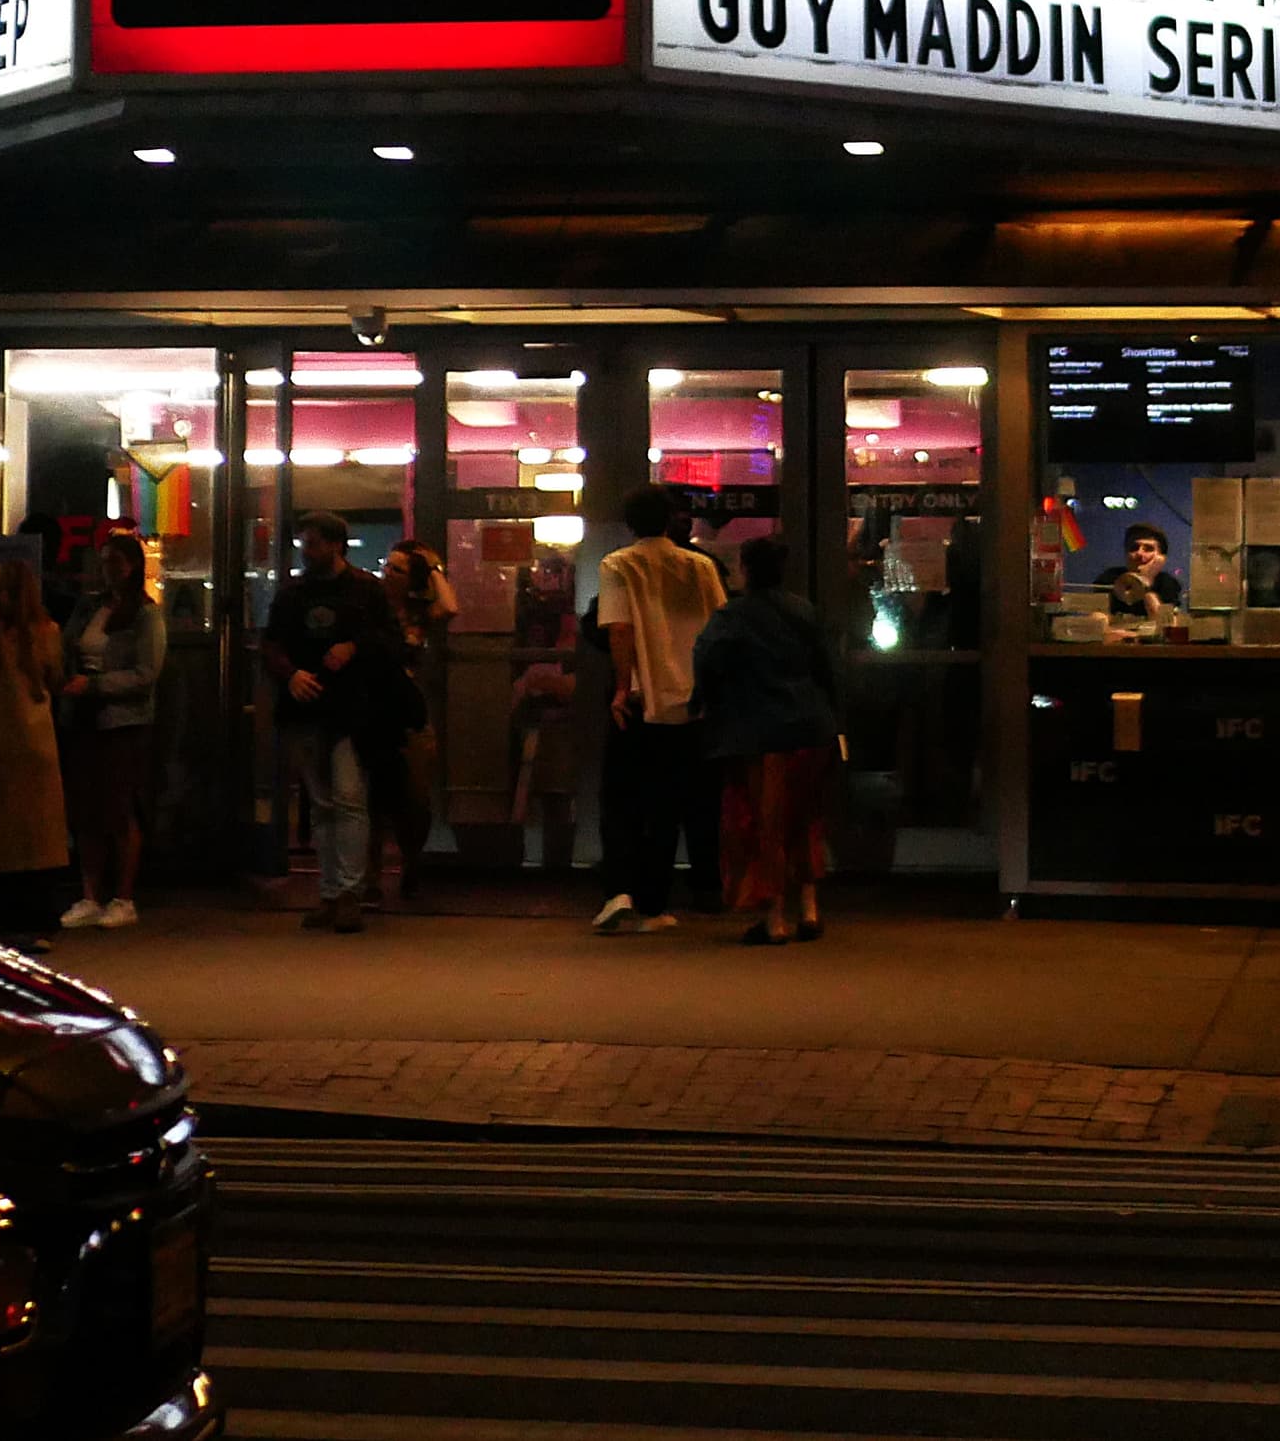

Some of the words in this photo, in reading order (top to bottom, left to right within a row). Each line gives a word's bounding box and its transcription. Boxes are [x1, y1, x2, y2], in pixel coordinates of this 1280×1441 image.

[1121, 346, 1179, 358] Showtimes
[850, 492, 916, 509] ENTRY
[921, 492, 978, 509] ONLY
